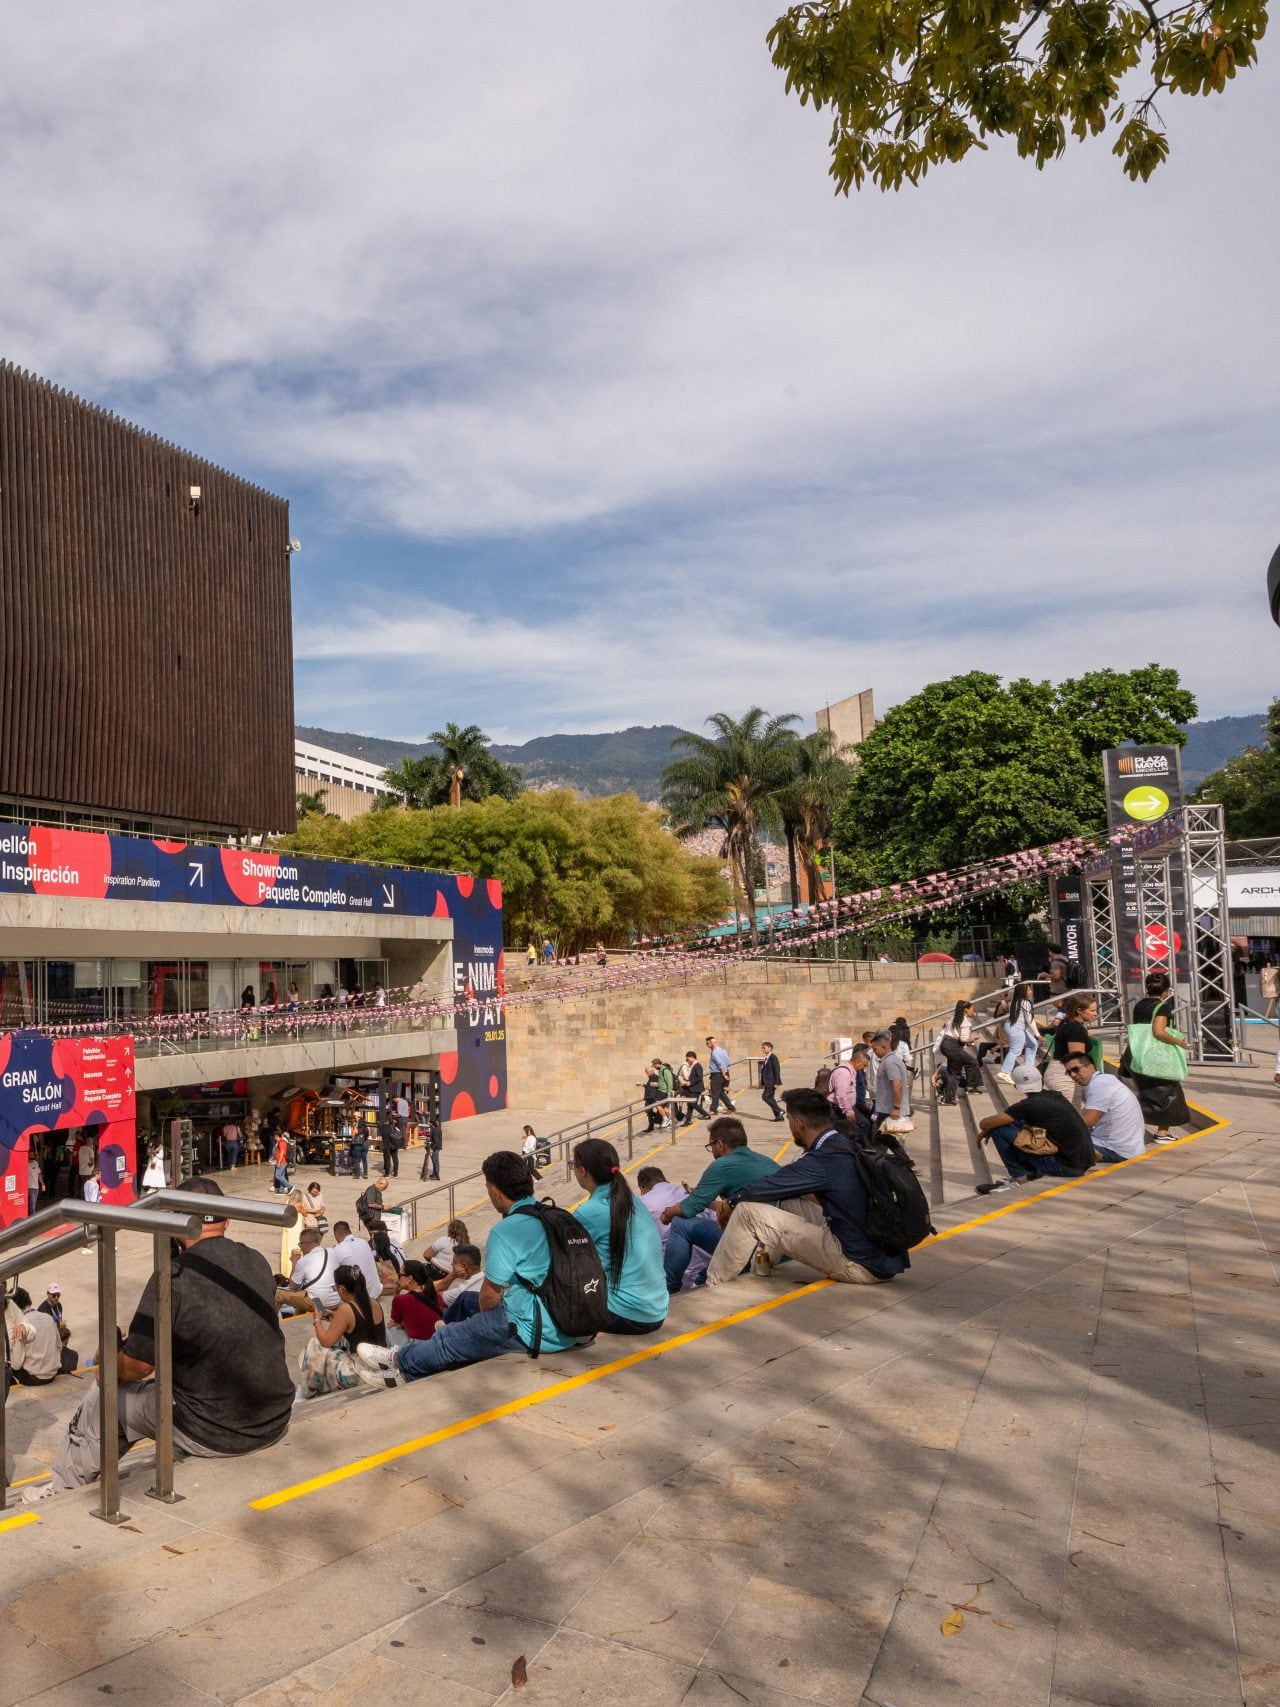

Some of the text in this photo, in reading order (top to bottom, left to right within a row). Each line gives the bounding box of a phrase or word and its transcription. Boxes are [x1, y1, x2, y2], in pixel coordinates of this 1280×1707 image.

[2, 860, 161, 888] Inspiración Inspiration Pavilion
[242, 858, 298, 881] Showroom
[258, 882, 373, 908] Paquete Completo Great Hall
[1066, 924, 1079, 959] MAYOR
[469, 997, 503, 1027] DAY
[2, 1069, 37, 1088] GRAN
[22, 1081, 62, 1104] SALÓN
[34, 1101, 63, 1113] Great Hall
